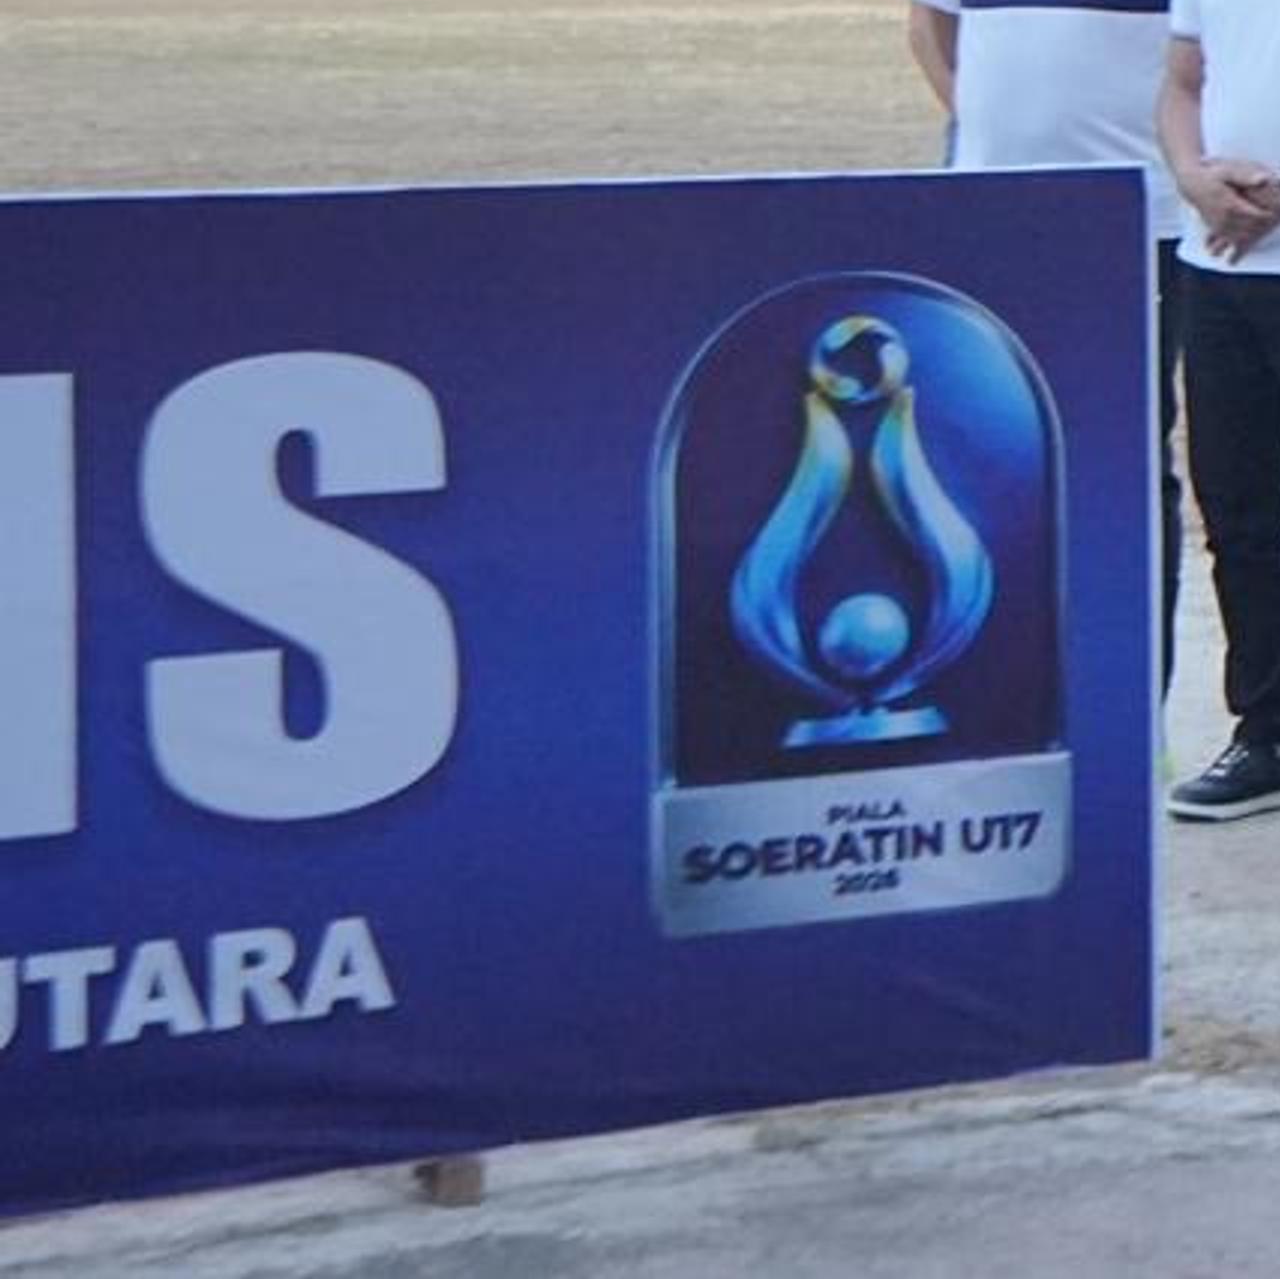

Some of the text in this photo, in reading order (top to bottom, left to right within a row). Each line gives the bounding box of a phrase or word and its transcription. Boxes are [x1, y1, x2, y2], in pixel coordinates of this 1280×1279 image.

[827, 800, 907, 825] PIALA
[682, 811, 1043, 884] SOERATIN U17
